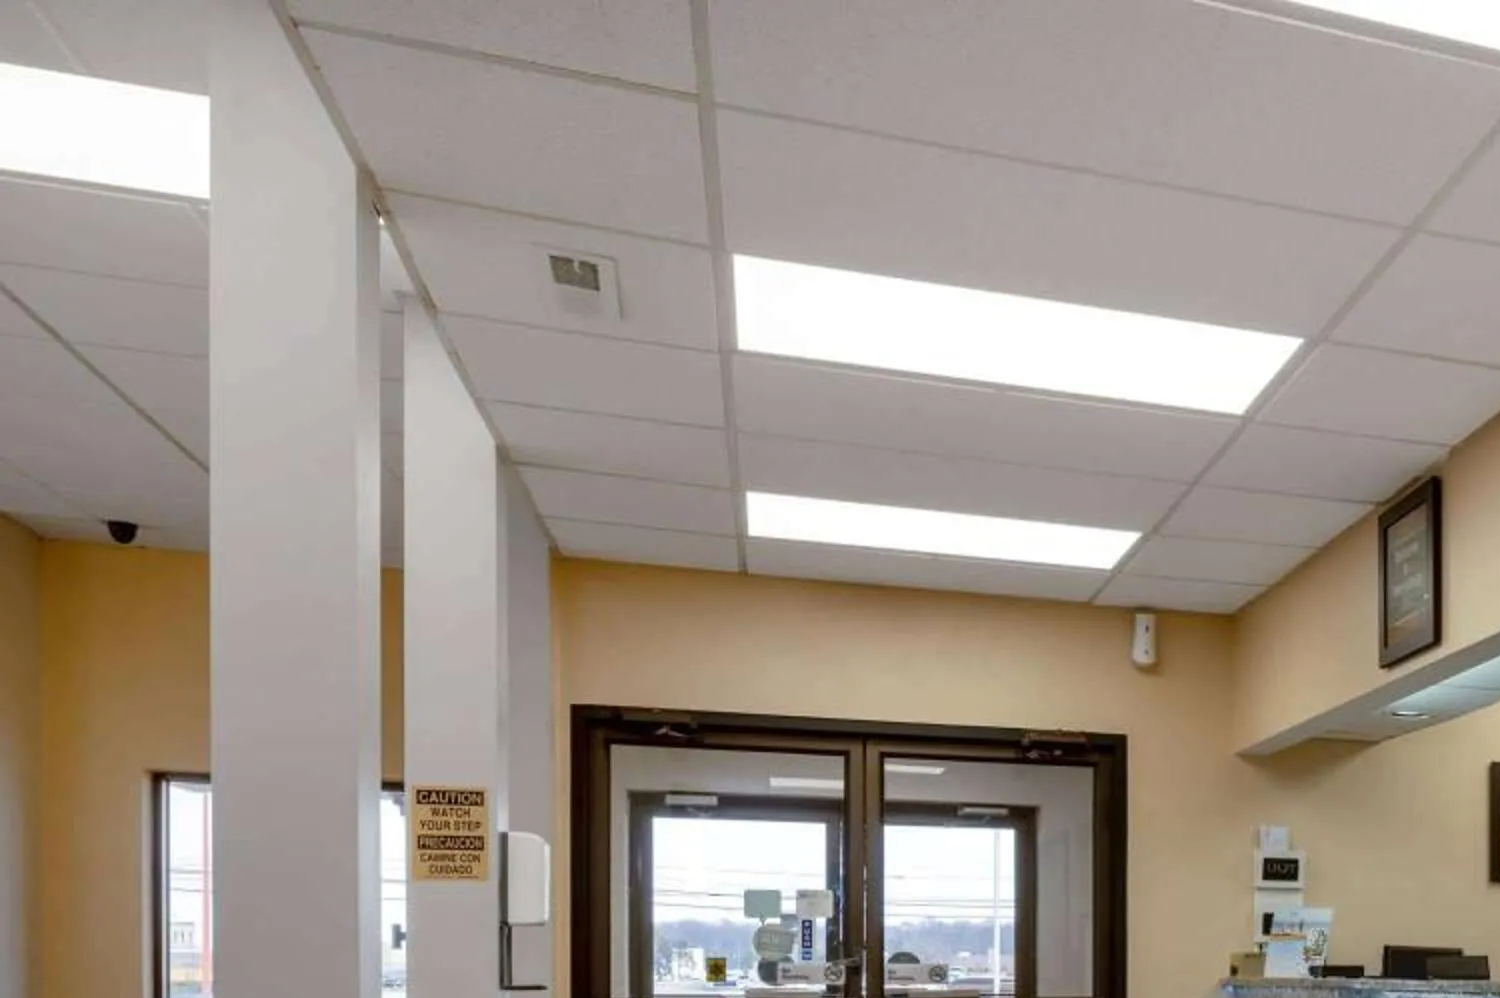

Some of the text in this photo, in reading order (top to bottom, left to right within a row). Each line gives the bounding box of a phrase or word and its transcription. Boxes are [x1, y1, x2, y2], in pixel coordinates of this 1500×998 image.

[419, 791, 481, 804] CAUTION
[430, 807, 471, 819] WATCH
[420, 819, 482, 831] YOUR STEP
[459, 853, 481, 863] CON
[428, 864, 473, 875] CUIDADO
